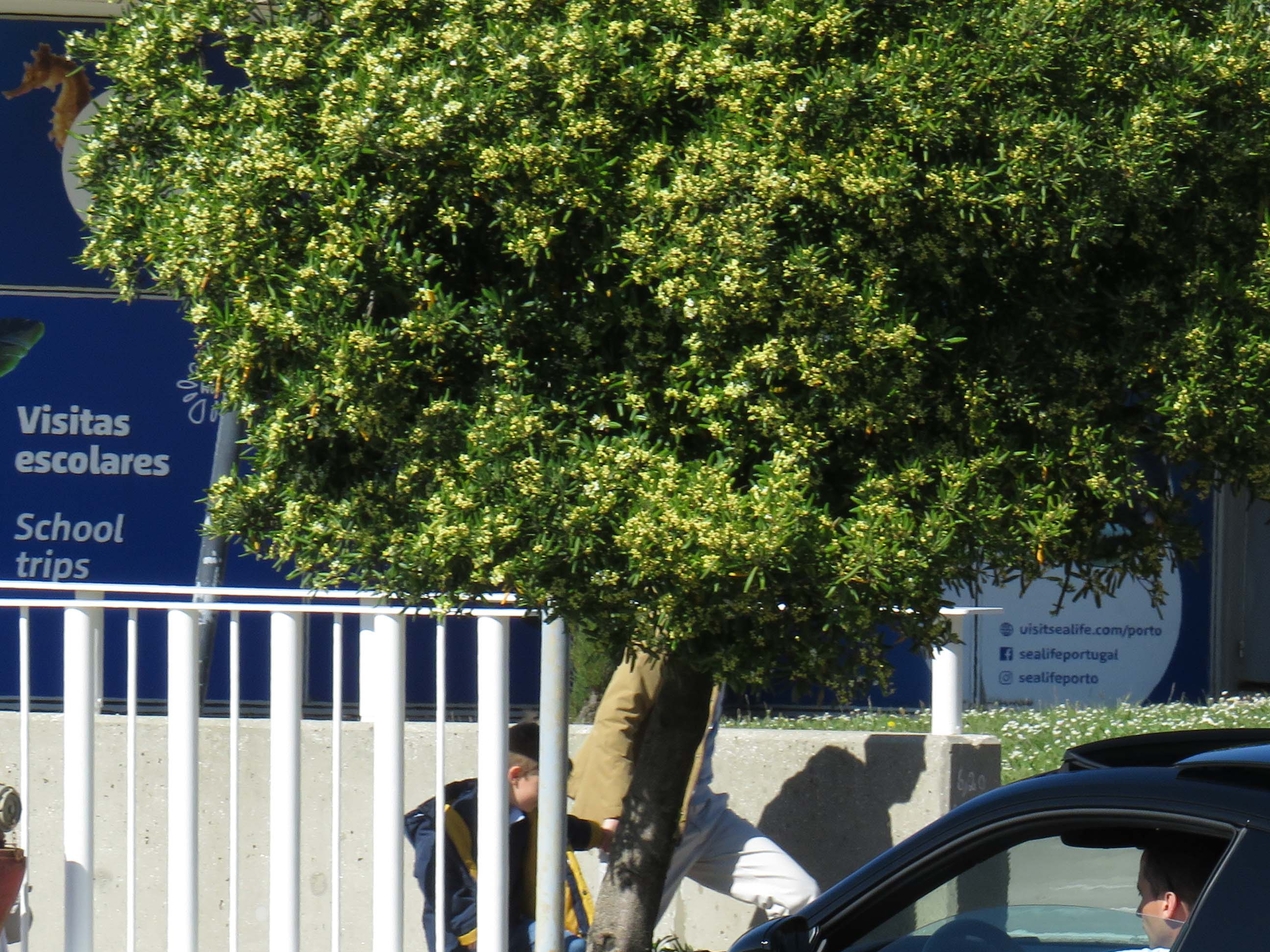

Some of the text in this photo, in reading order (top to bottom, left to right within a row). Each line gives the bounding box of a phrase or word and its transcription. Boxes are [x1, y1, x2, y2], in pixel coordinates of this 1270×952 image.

[17, 404, 131, 436] Visitas
[15, 444, 170, 476] escolares
[14, 512, 125, 543] School
[16, 549, 91, 582] trips
[1019, 623, 1162, 638] visitsealife.com/porto
[1019, 647, 1119, 663] sealifeportugal
[1018, 671, 1099, 686] sealifeporto
